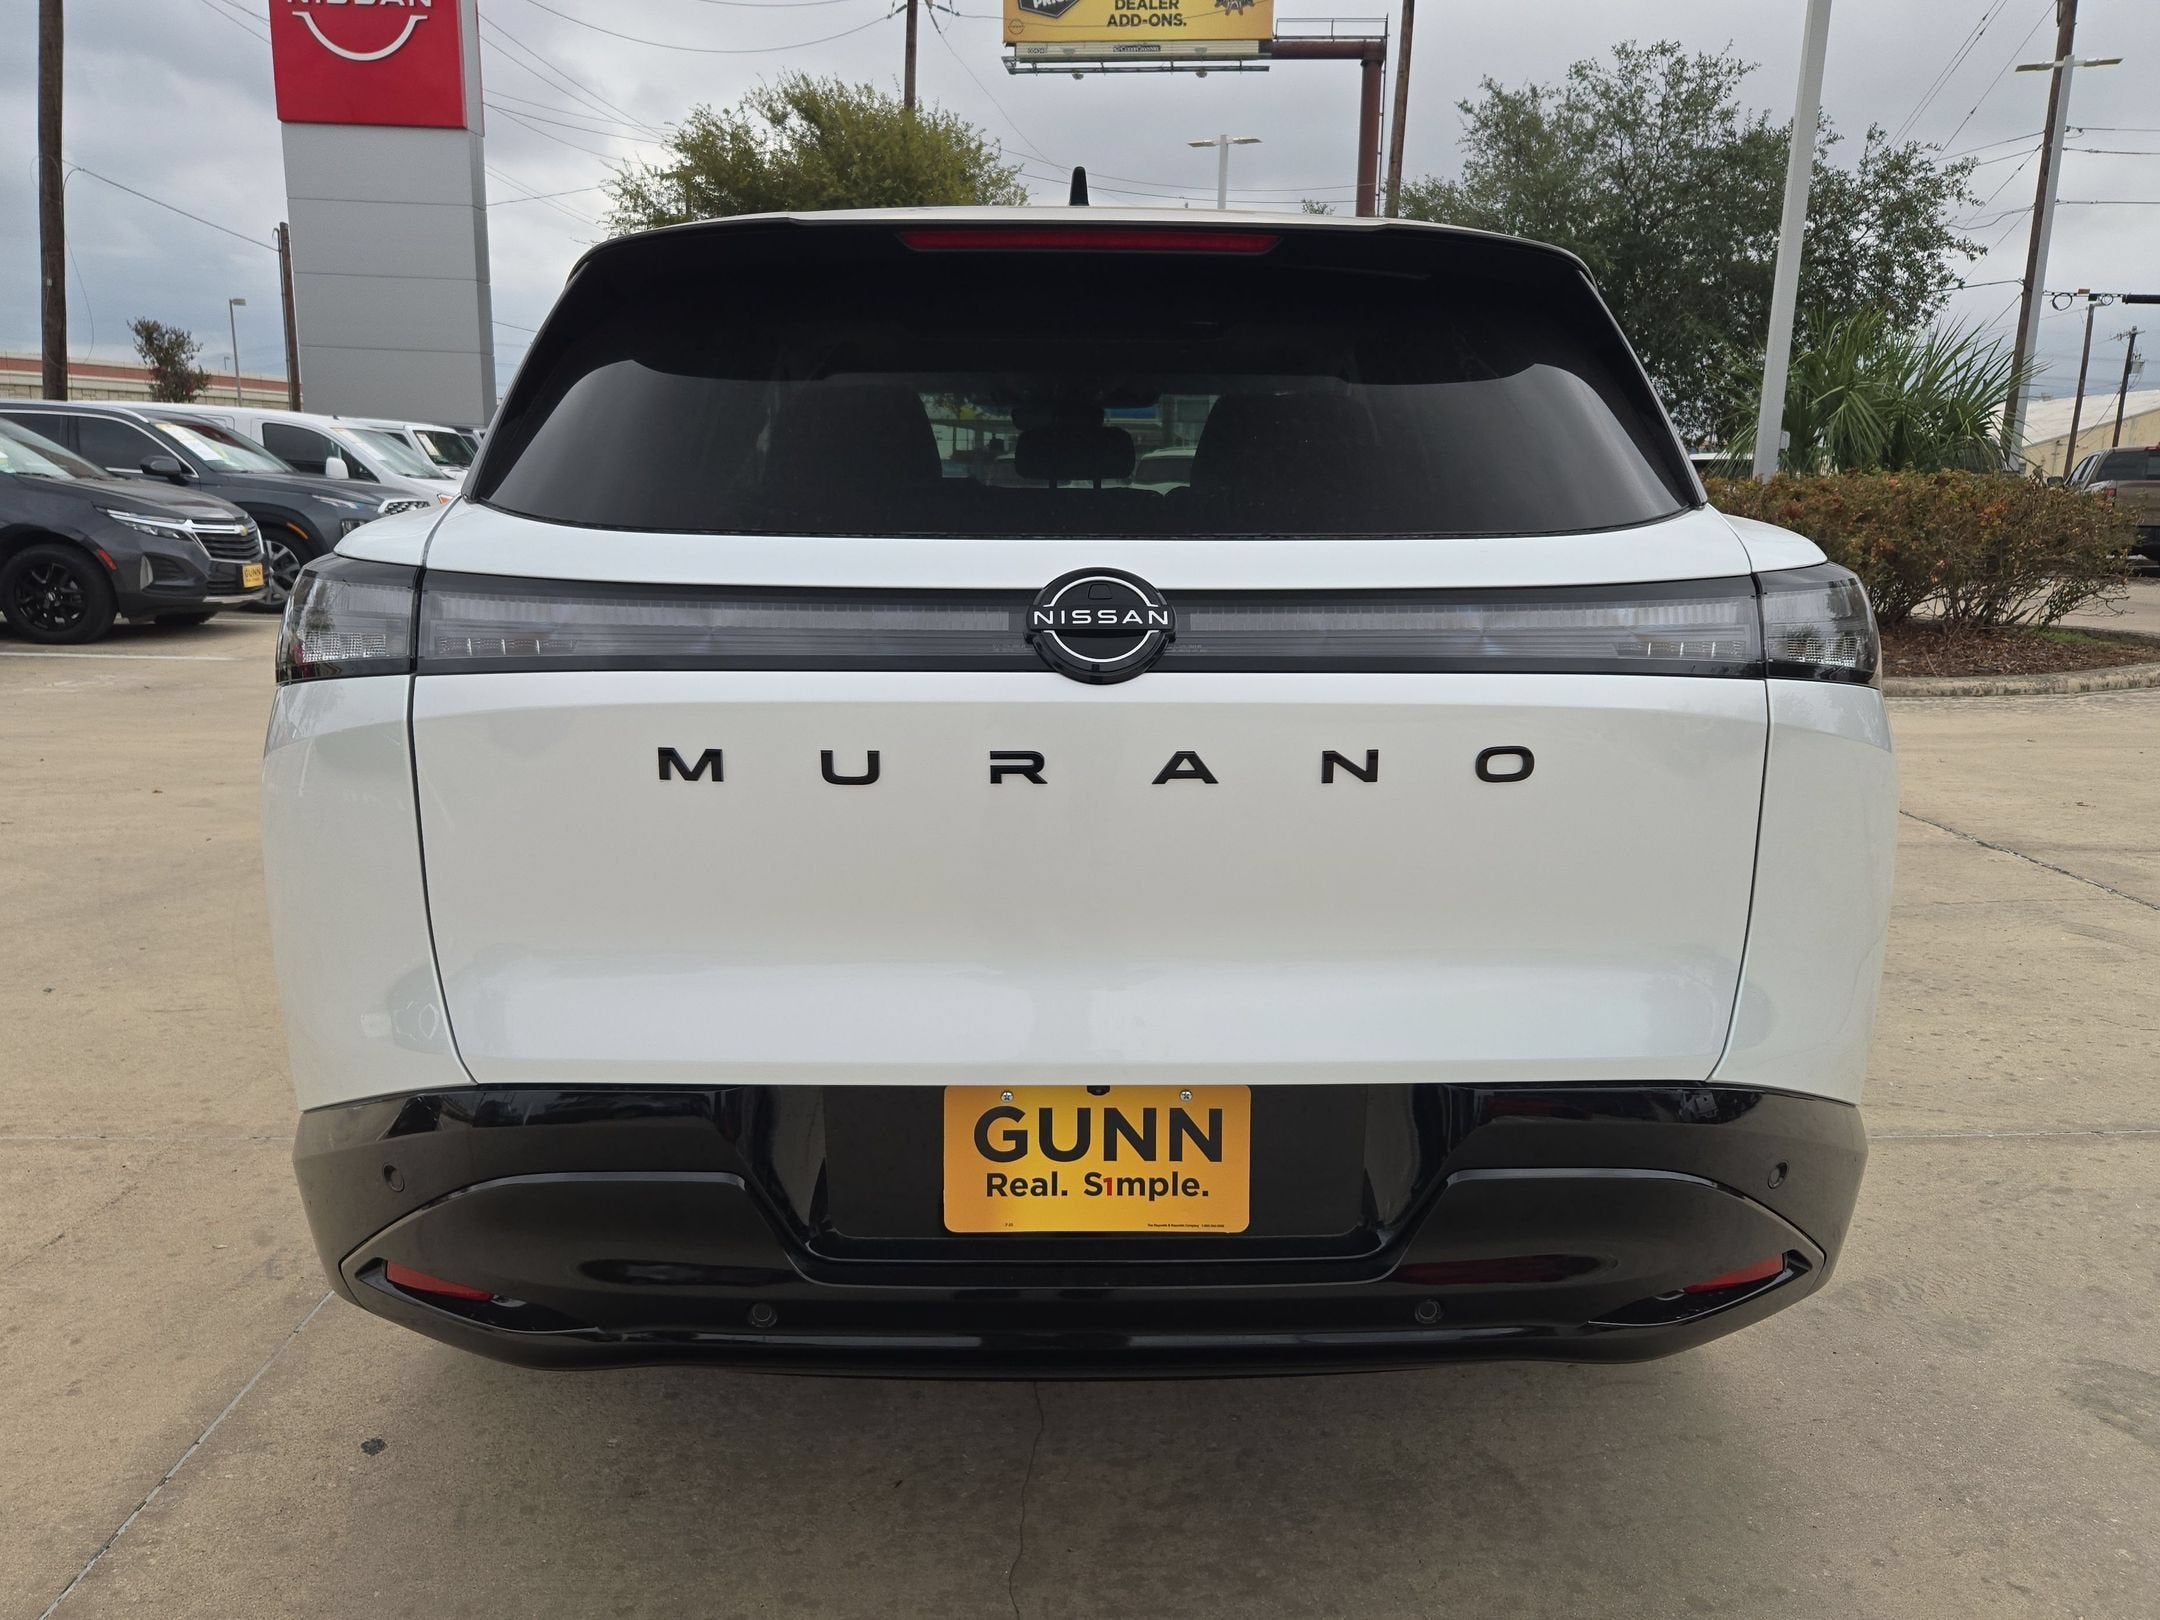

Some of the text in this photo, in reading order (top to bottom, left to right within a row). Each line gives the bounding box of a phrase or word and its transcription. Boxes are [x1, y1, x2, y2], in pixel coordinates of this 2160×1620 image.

[1115, 0, 1179, 10] DEALER
[1107, 13, 1187, 27] ADD-ONS.
[1033, 609, 1169, 625] NISSAN
[657, 746, 1535, 786] MURANO
[974, 1106, 1223, 1163] GUNN
[986, 1171, 1209, 1202] Real. S1mple.
